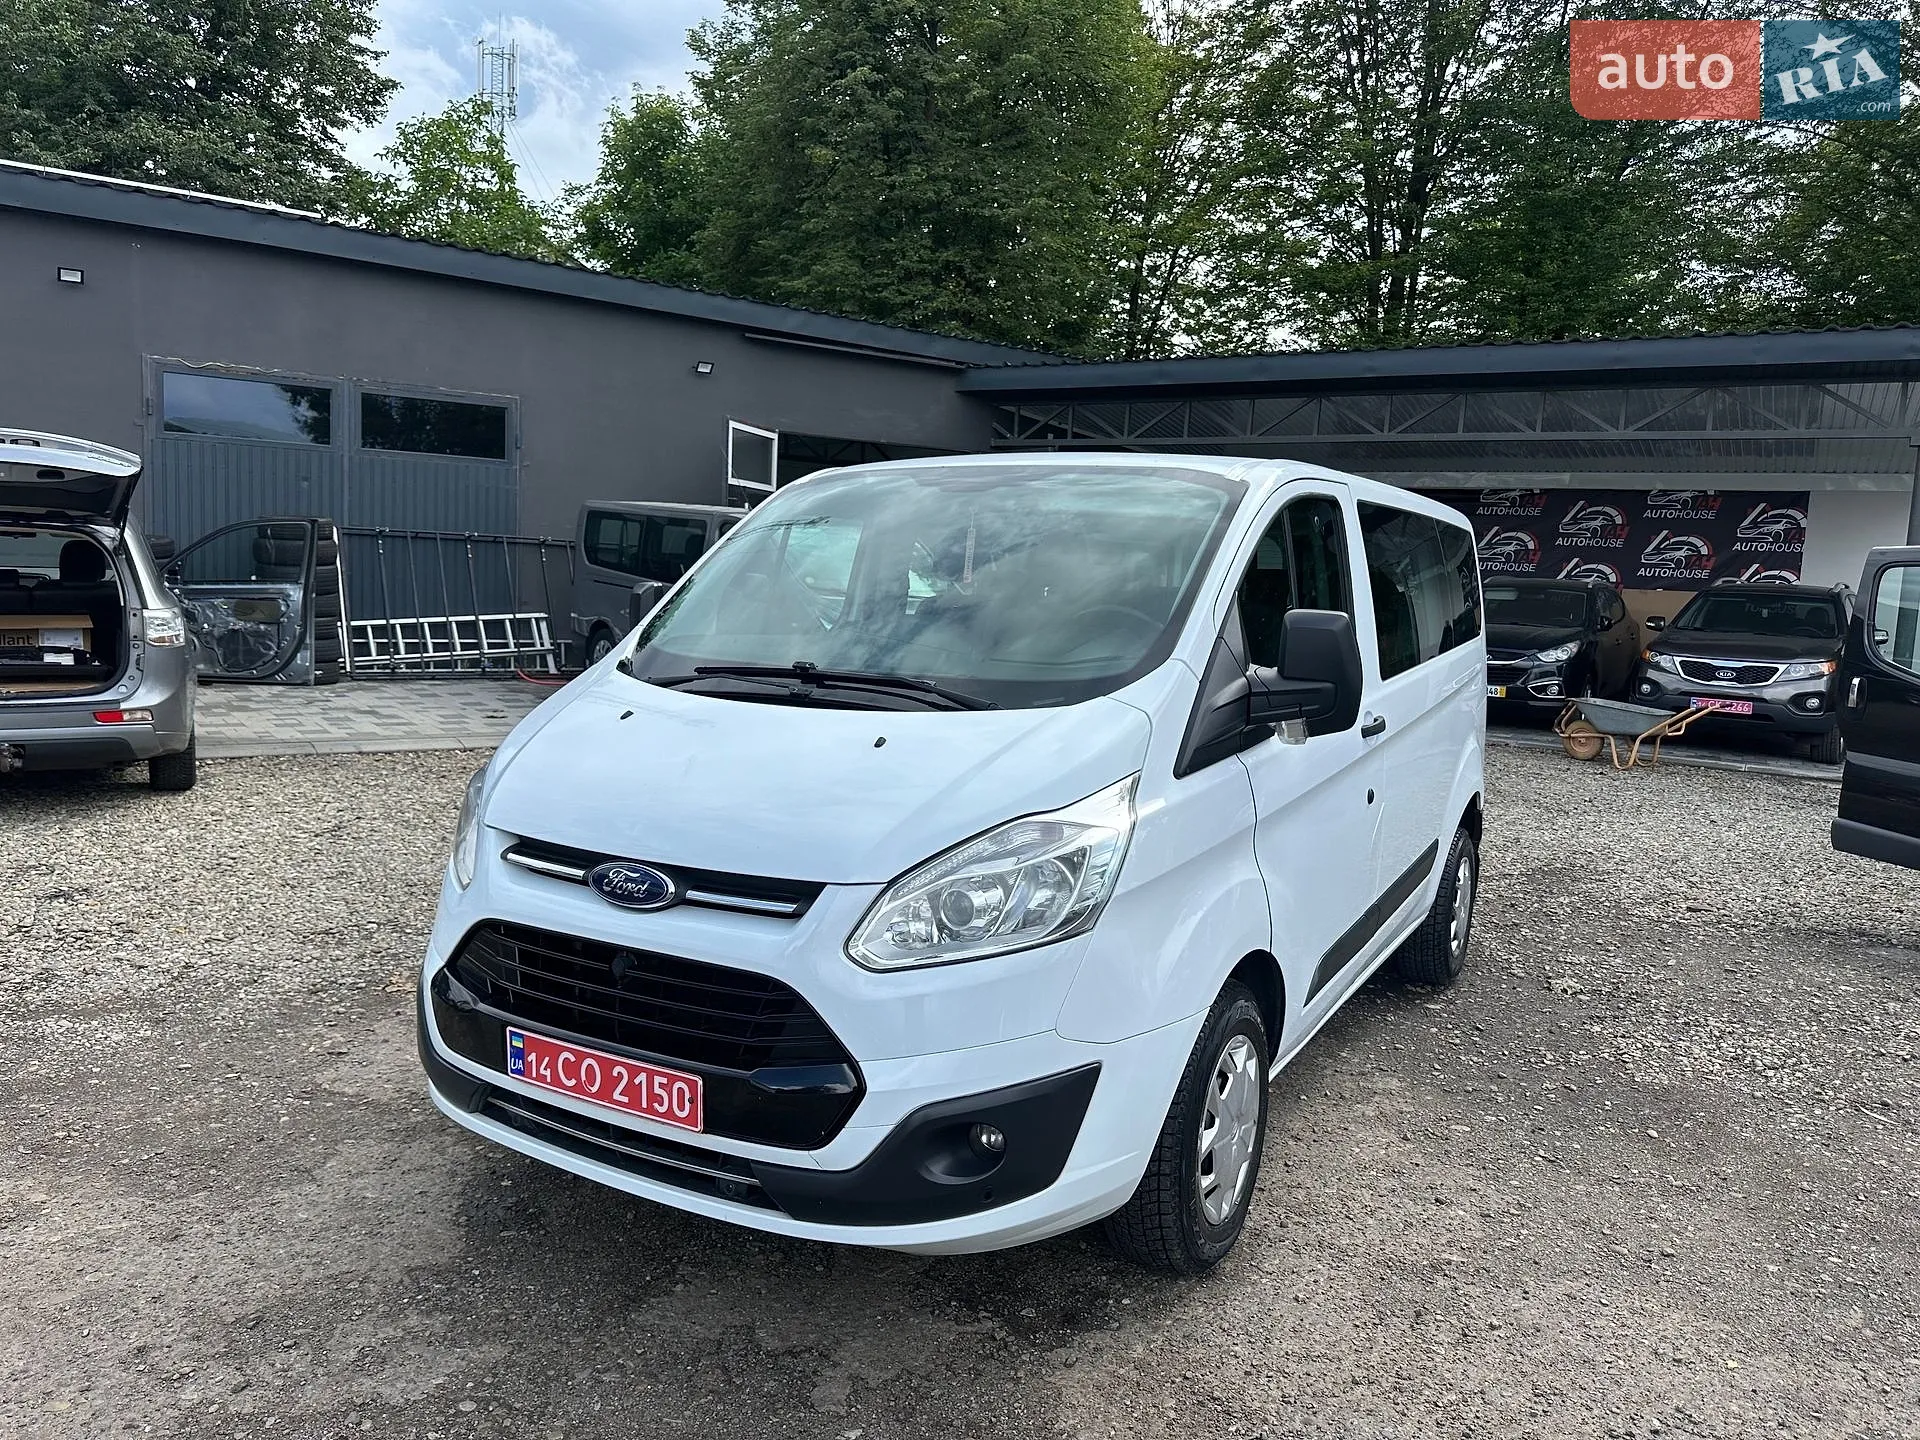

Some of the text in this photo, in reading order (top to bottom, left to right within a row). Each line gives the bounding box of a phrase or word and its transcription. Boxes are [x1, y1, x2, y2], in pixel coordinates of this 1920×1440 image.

[1476, 506, 1543, 516] AUTOHOUSE
[1643, 509, 1717, 520] AUTOHOUSE
[1555, 537, 1625, 548] AUTOHOUSE
[1732, 542, 1804, 553] AUTOHOUS
[1479, 562, 1537, 572] UTOHOUSE
[1637, 567, 1711, 579] AUTOHOUSE
[603, 868, 651, 897] Ford
[511, 1057, 524, 1071] UA
[527, 1051, 693, 1118] 14 CO 2150
